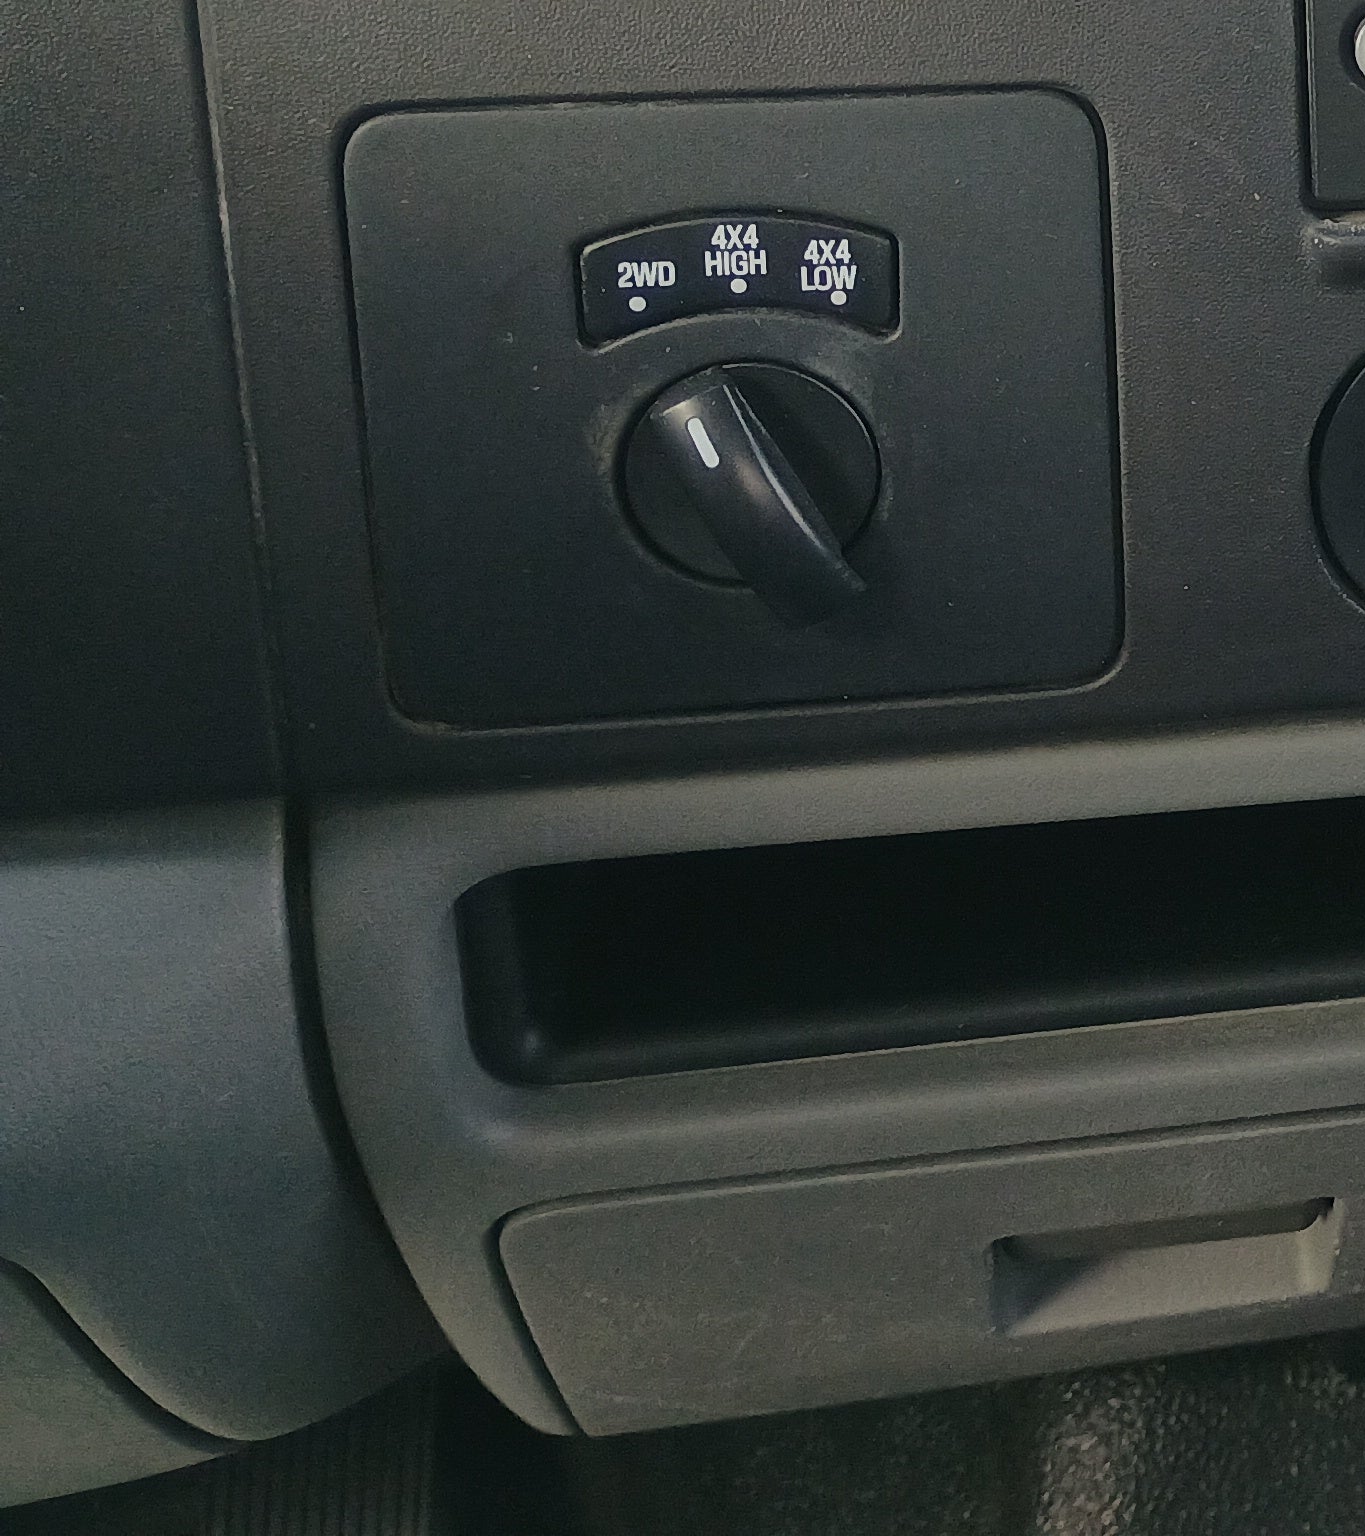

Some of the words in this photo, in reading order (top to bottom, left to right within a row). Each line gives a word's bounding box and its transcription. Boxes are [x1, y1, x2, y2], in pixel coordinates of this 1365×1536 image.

[711, 223, 760, 250] 4X4
[704, 249, 768, 277] HIGH
[803, 238, 852, 265] 4X4
[617, 261, 676, 288] 2WD
[800, 264, 857, 292] LOW
